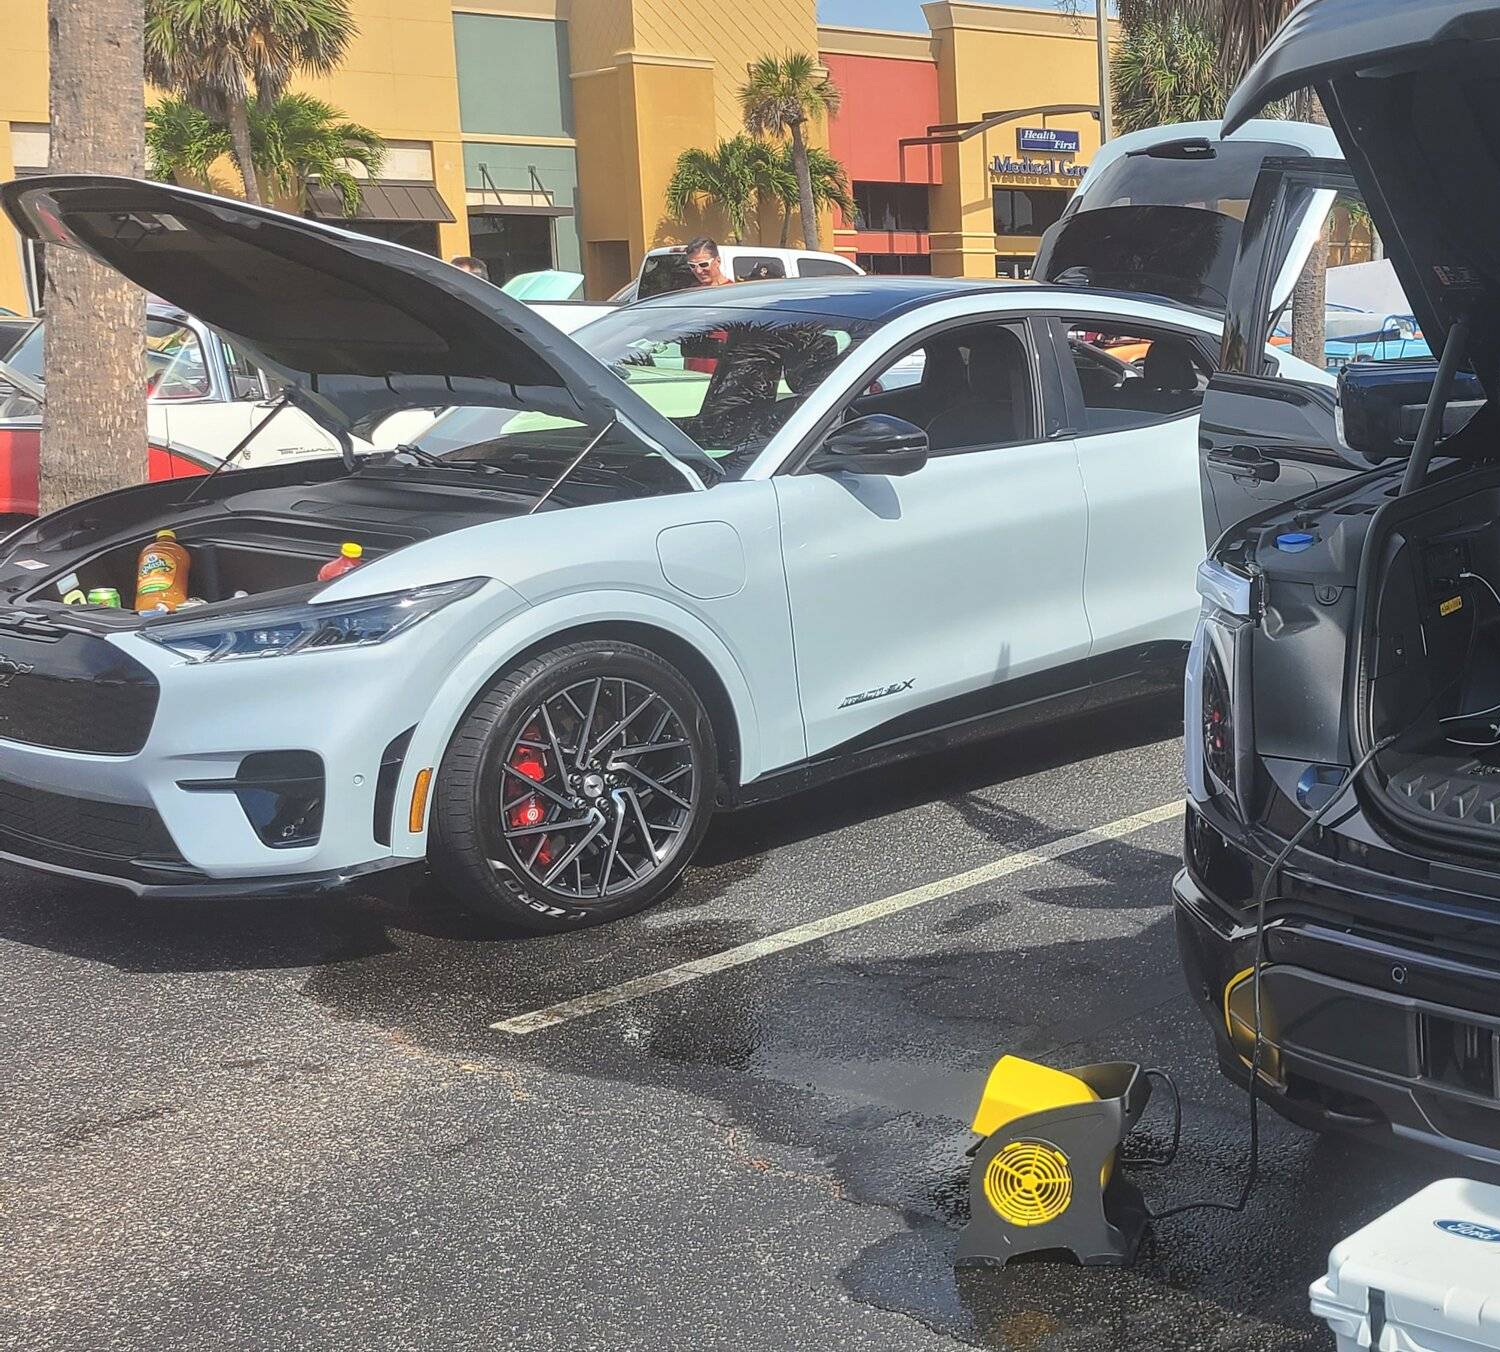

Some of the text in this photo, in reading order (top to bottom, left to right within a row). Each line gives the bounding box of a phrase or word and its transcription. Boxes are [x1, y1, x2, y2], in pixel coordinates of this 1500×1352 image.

[1024, 130, 1056, 140] Health
[1054, 140, 1077, 150] First
[991, 155, 1089, 177] Medical Gro
